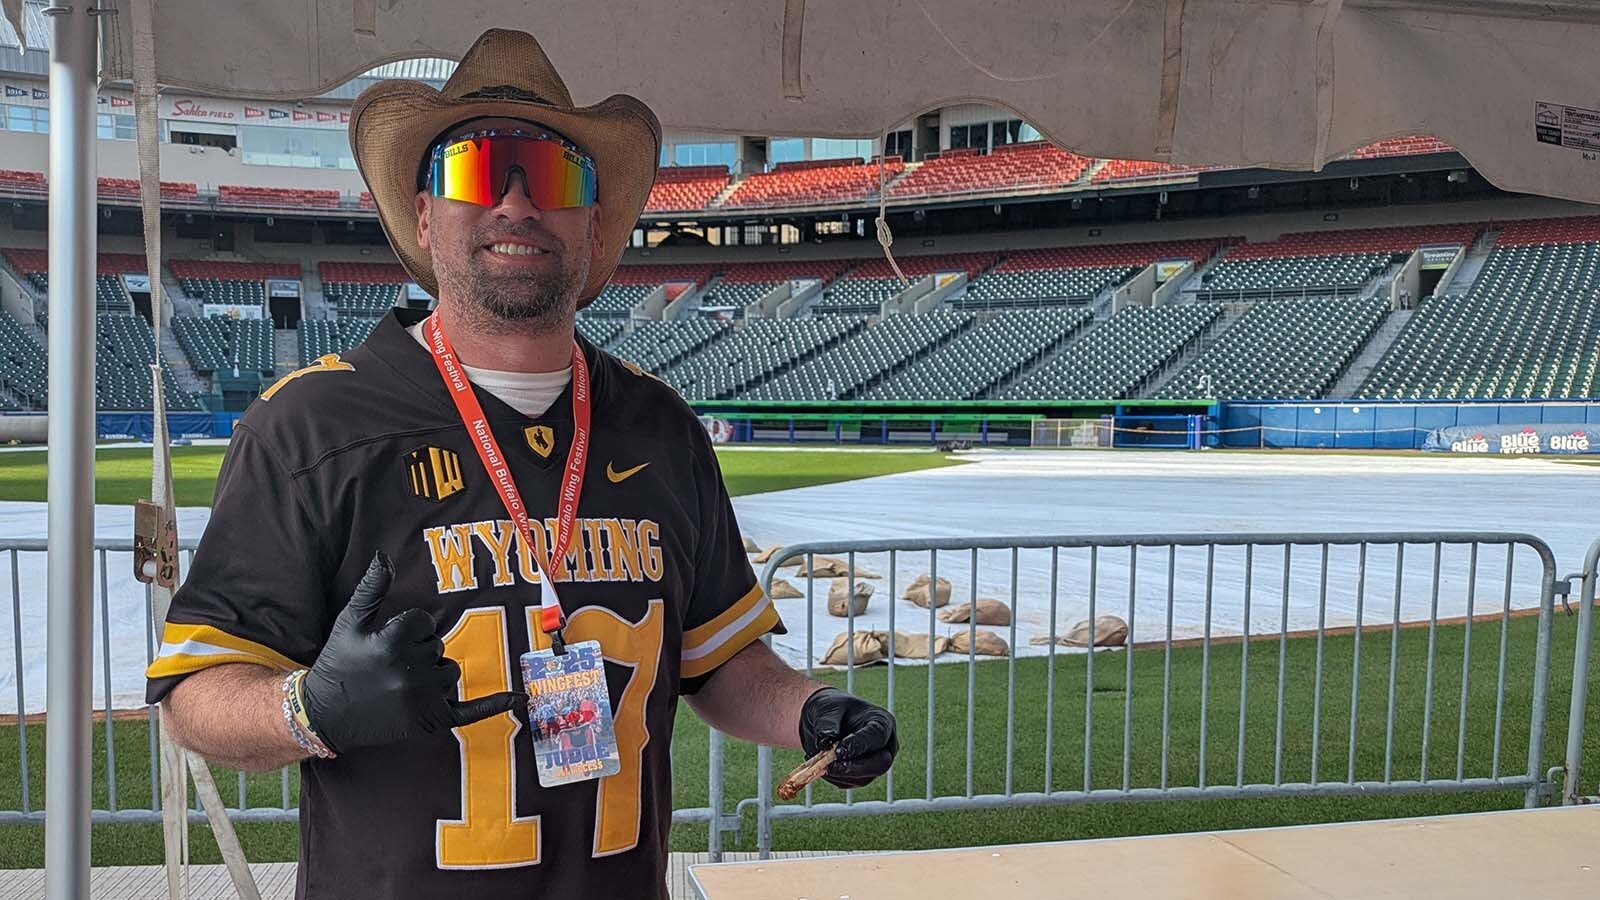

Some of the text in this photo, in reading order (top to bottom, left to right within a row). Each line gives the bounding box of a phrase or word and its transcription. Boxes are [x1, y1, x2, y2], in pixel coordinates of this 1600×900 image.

[209, 110, 234, 119] FIELD
[444, 143, 470, 159] BILLS
[563, 151, 586, 169] BILLS
[432, 327, 468, 392] Wing Festival
[577, 360, 586, 402] National
[570, 427, 586, 472] Festival
[1501, 434, 1540, 448] Blue
[1551, 435, 1589, 450] Blue
[473, 419, 502, 467] National
[495, 468, 520, 510] Buffalo
[564, 474, 580, 502] Wing
[560, 504, 573, 545] Buffalo
[424, 518, 664, 594] WYOMING
[528, 670, 600, 696] WINGFEST
[436, 599, 665, 870] 17
[544, 743, 610, 770] JUDGE
